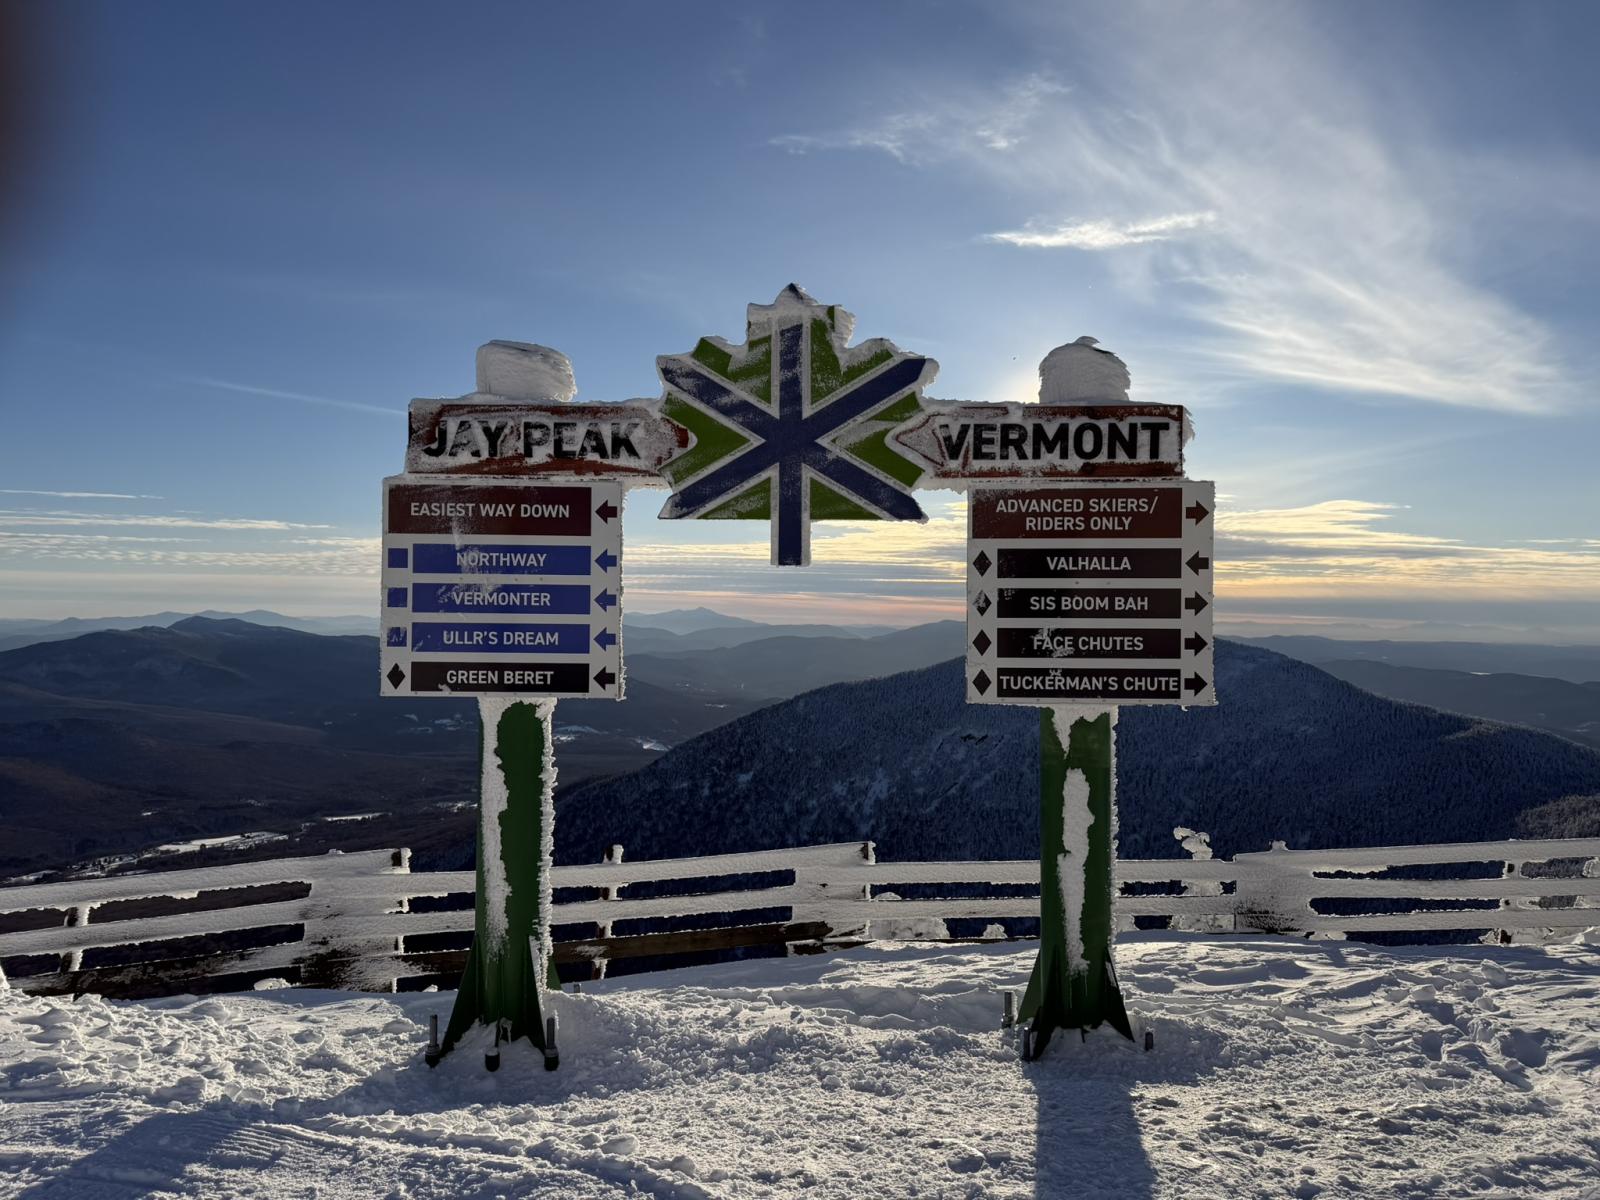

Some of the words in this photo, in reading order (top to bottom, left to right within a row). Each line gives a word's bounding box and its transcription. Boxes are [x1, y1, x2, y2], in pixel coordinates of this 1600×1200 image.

[422, 419, 508, 457] JAY
[523, 421, 641, 459] PEAK
[939, 422, 1170, 460] VERMONT
[410, 502, 475, 517] EASIEST
[480, 504, 516, 517] WAY
[520, 504, 570, 518] DOWN
[996, 499, 1083, 513] ADVANCED
[1089, 496, 1158, 514] SKIERS/
[1025, 516, 1085, 531] RIDERS
[1090, 516, 1132, 530] ONLY
[456, 553, 547, 567] NORTHWAY
[1046, 557, 1132, 571] VALHALLA
[452, 591, 551, 606] VERMONTER
[1030, 596, 1056, 610] SIS
[1061, 596, 1110, 610] BOOM
[1114, 597, 1149, 611] BAH
[443, 631, 498, 645] ULLR'S
[503, 632, 559, 645] DREAM
[1033, 636, 1073, 650] FACE
[1078, 637, 1144, 651] CHUTES
[446, 670, 498, 684] GREEN
[503, 671, 554, 685] BERET
[1000, 676, 1118, 691] TUCKERMAN'S
[1123, 677, 1178, 691] CHUTE
